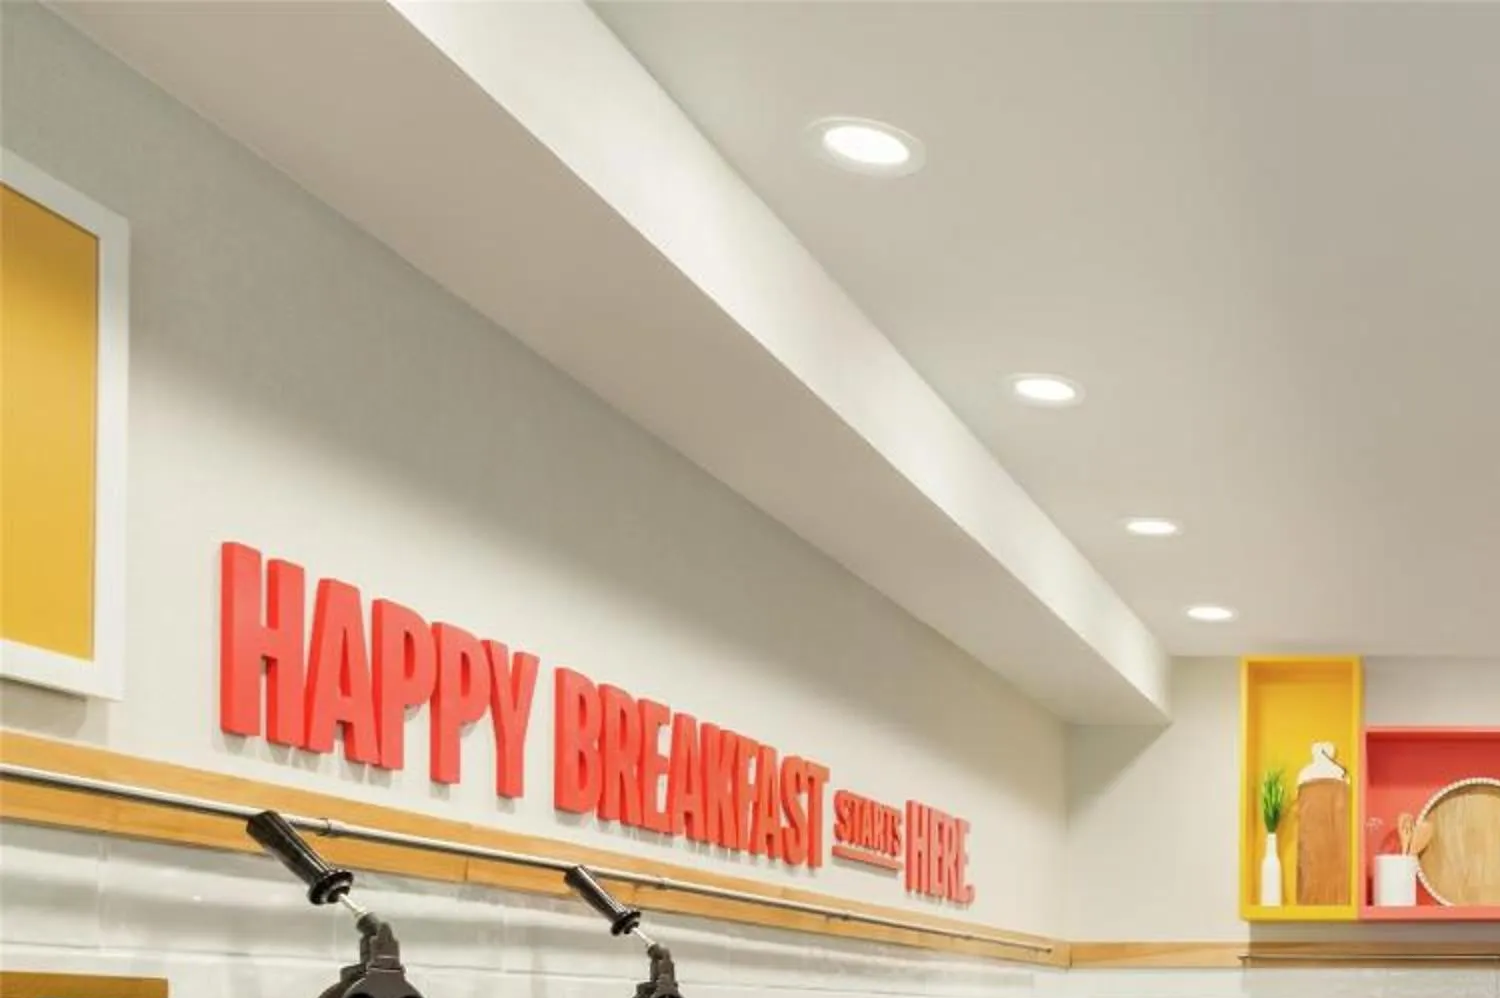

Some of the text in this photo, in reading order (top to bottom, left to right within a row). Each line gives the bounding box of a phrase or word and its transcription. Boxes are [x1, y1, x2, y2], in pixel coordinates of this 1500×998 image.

[220, 541, 540, 799] HAPPY
[553, 667, 830, 868] BREAKFAST
[833, 789, 903, 857] STARTS
